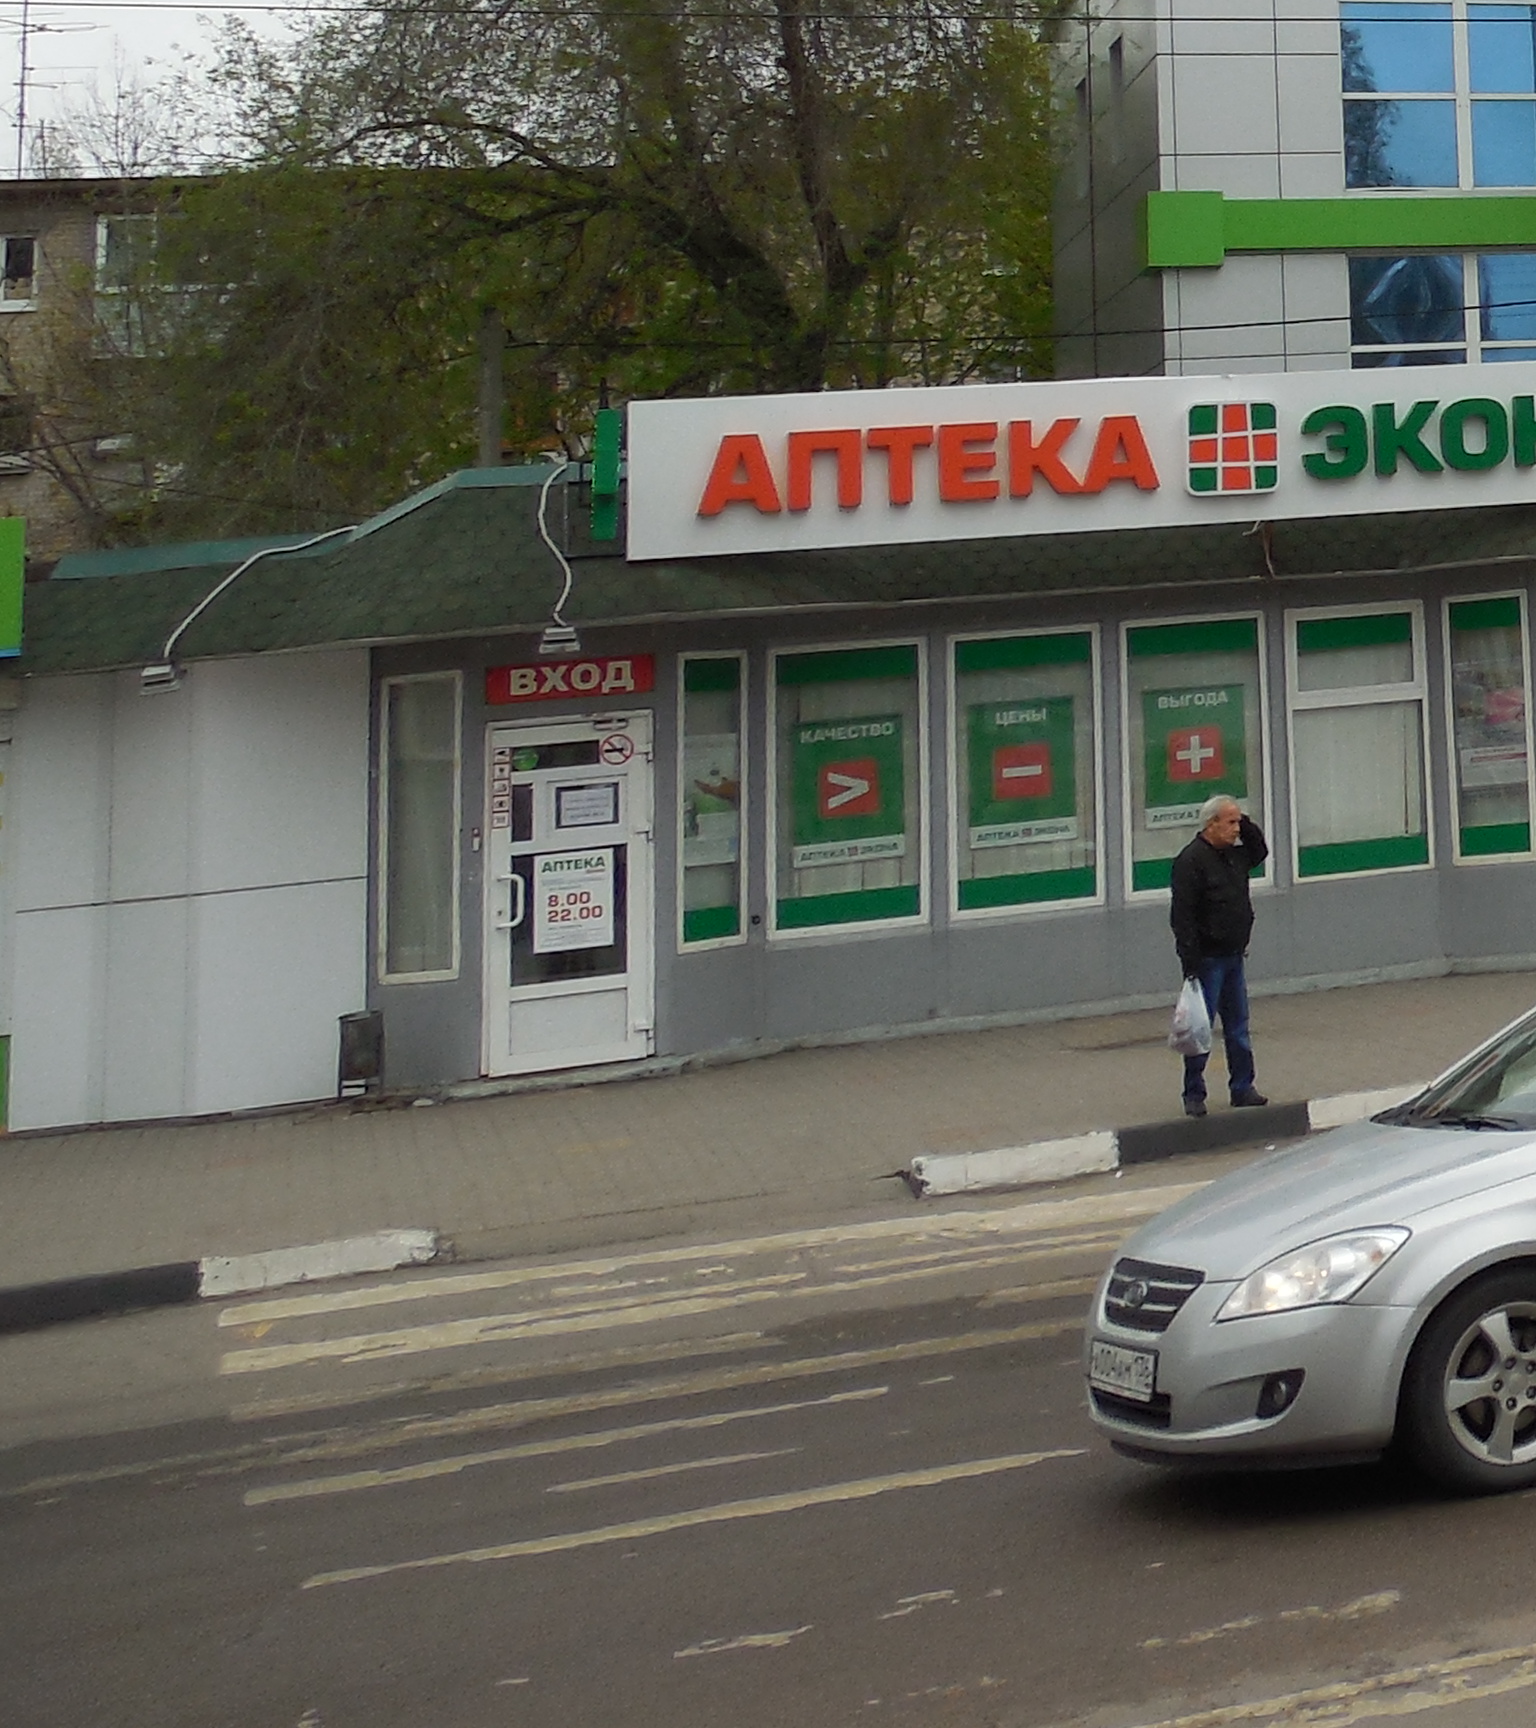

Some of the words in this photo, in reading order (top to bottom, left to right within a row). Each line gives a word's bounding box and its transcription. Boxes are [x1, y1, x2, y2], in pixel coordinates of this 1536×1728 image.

[696, 414, 1160, 516] АПТЕКА
[510, 661, 634, 696] ВХОД
[1158, 691, 1228, 709] ВЫГОДА
[995, 708, 1047, 727] ЦЕНЫ
[800, 722, 894, 744] КАЧЕСТВО
[542, 856, 605, 873] АПТЕКА
[548, 891, 591, 907] 8.00
[548, 905, 603, 923] 22.00
